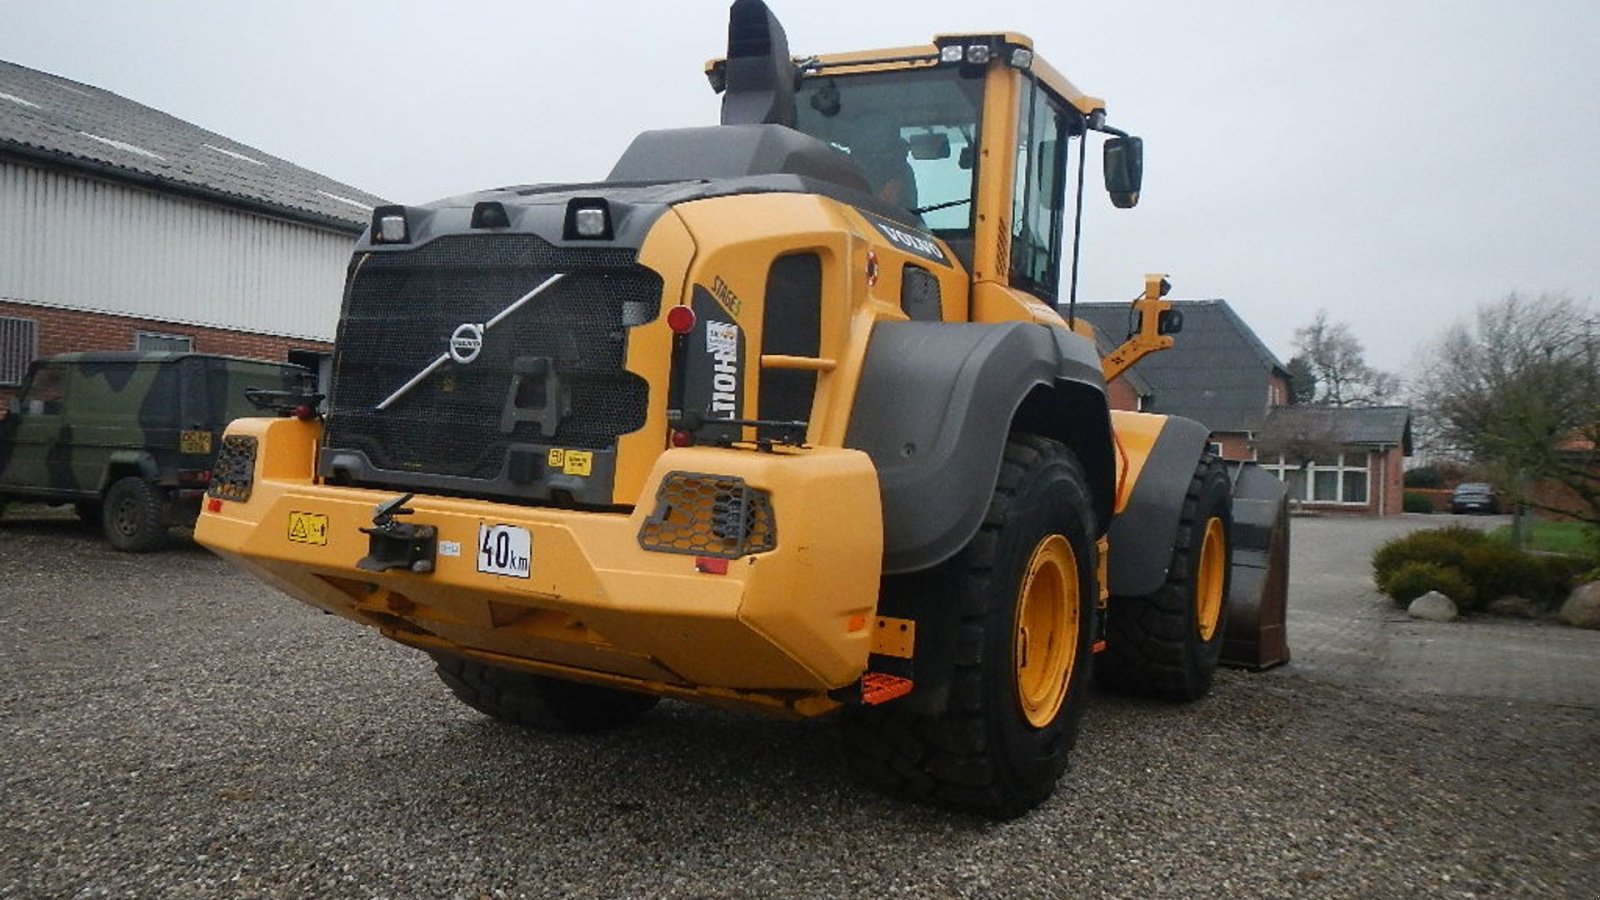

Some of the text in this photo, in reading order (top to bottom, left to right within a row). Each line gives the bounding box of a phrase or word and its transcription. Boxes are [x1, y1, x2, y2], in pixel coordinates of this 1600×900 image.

[878, 223, 943, 258] VOLVO
[481, 530, 528, 571] 40 km
